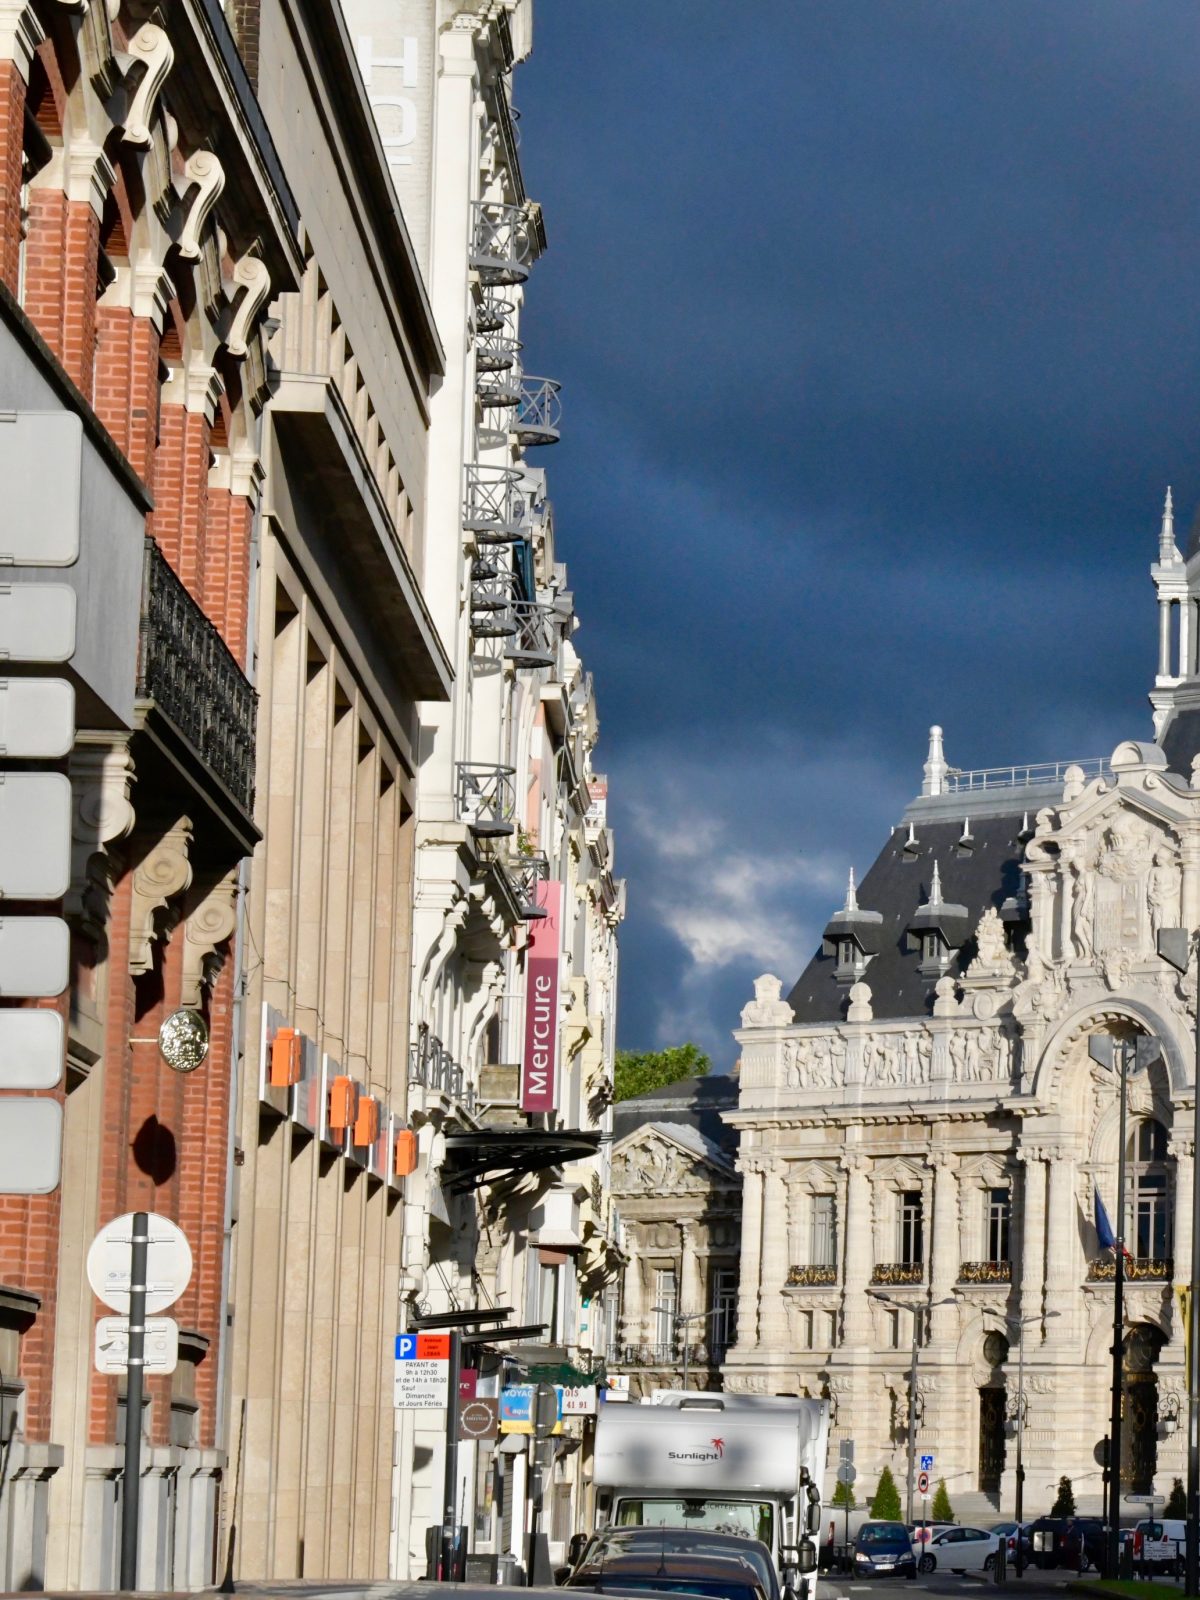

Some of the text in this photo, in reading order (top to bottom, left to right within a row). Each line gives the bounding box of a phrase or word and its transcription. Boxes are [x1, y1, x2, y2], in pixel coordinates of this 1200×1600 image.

[528, 975, 551, 1095] Mercure
[400, 1338, 412, 1357] P
[668, 1451, 719, 1461] Sunlight
